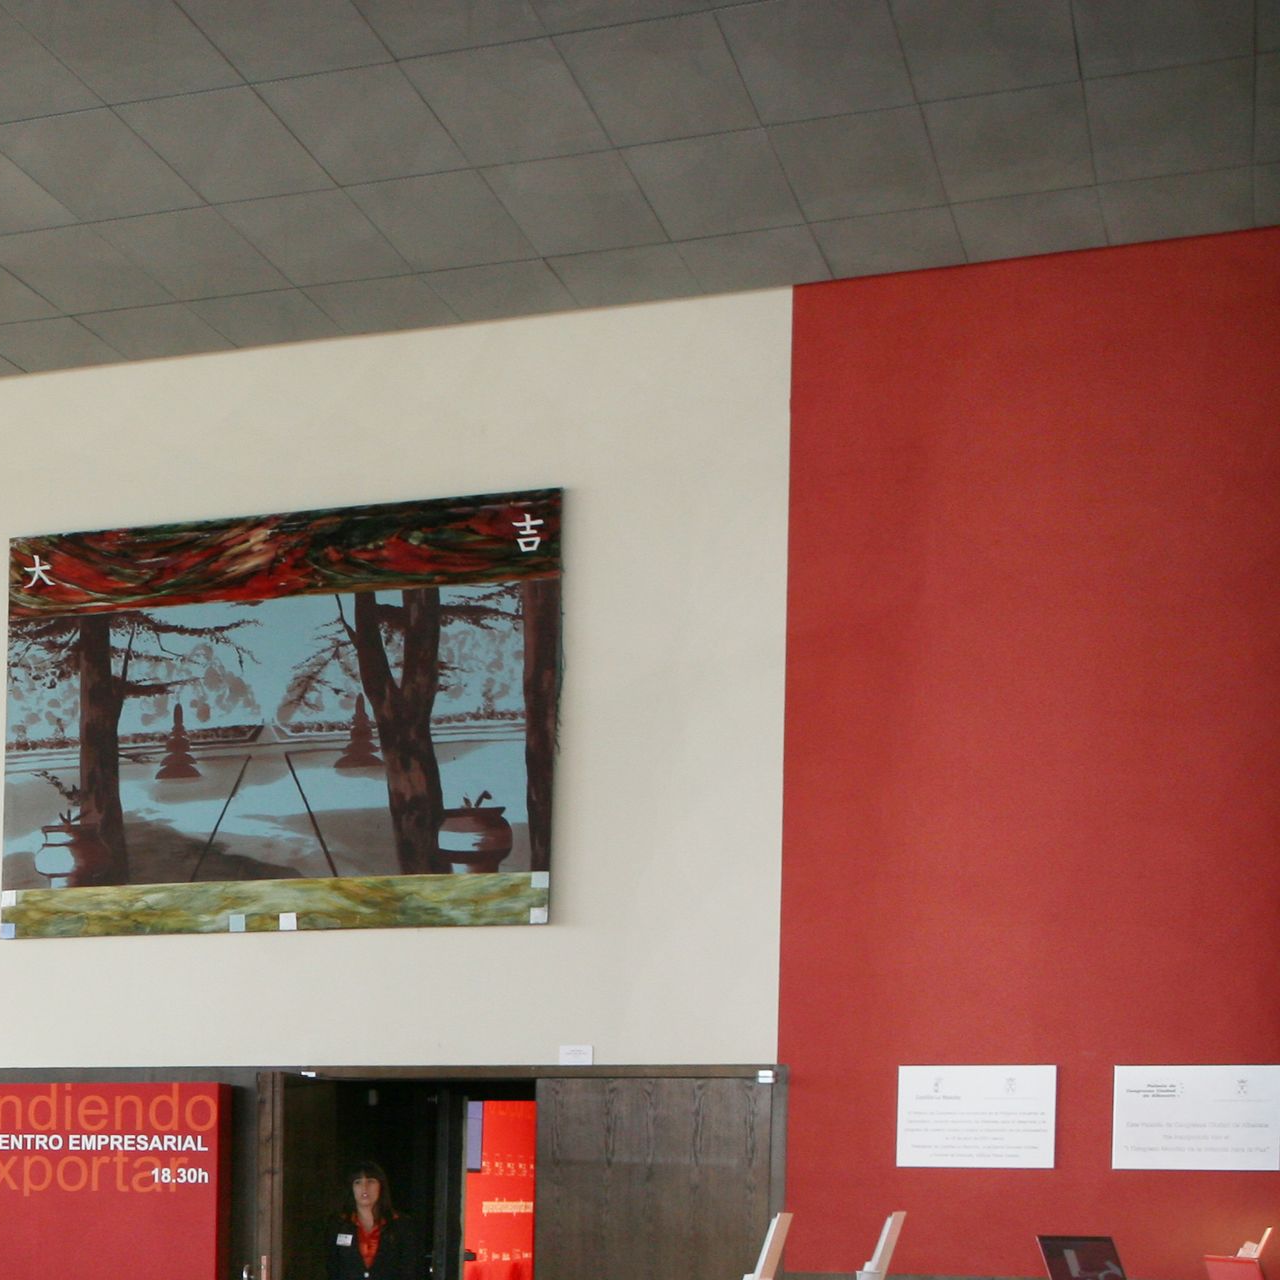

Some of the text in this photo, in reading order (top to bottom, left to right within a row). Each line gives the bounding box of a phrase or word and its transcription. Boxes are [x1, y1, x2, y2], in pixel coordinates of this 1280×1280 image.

[512, 513, 543, 552] 吉
[23, 554, 56, 589] 大
[68, 1133, 209, 1151] EMPRESARIAL
[151, 1167, 209, 1184] 18.30h
